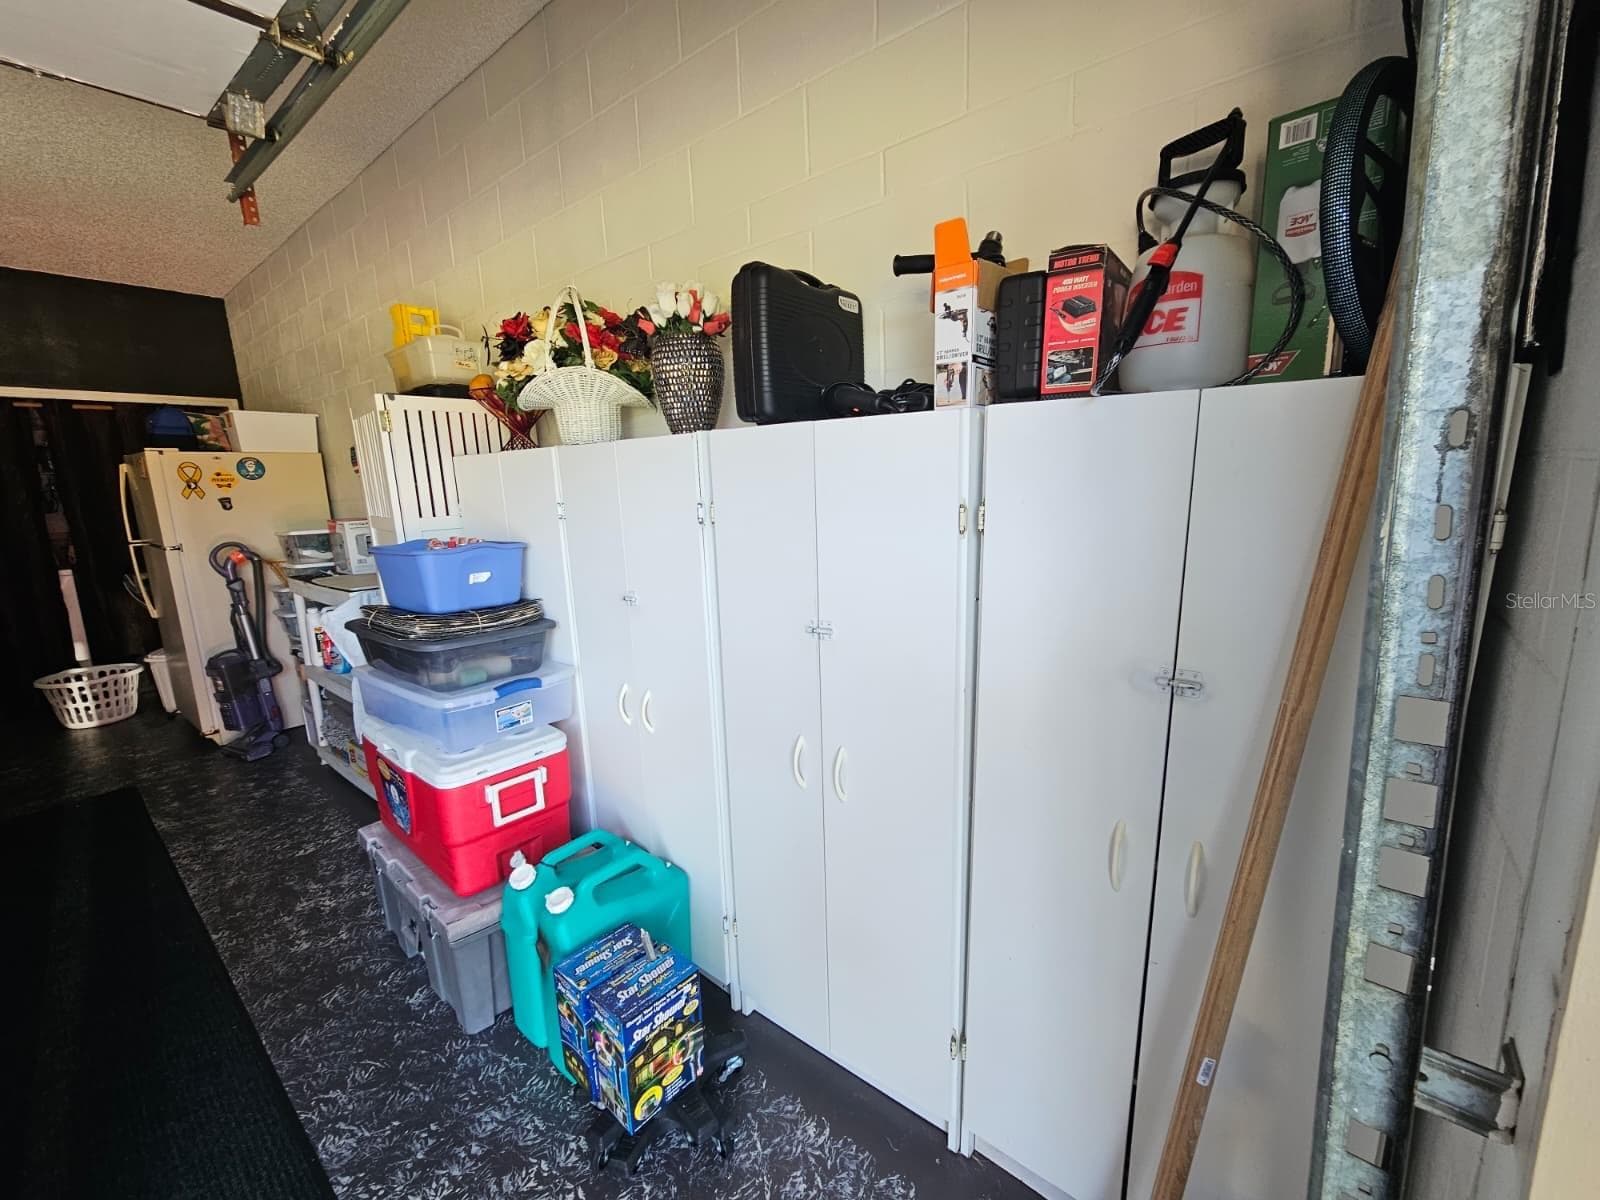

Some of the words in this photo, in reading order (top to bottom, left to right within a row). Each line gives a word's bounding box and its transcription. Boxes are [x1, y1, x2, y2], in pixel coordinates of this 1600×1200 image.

[1290, 212, 1313, 226] ACE
[1167, 280, 1198, 294] arden
[1142, 307, 1189, 335] CE
[613, 935, 633, 952] Star
[574, 948, 613, 976] Shower
[616, 982, 638, 1003] Star
[638, 956, 675, 987] Shower
[633, 1022, 653, 1042] Star
[652, 995, 686, 1029] Shower
